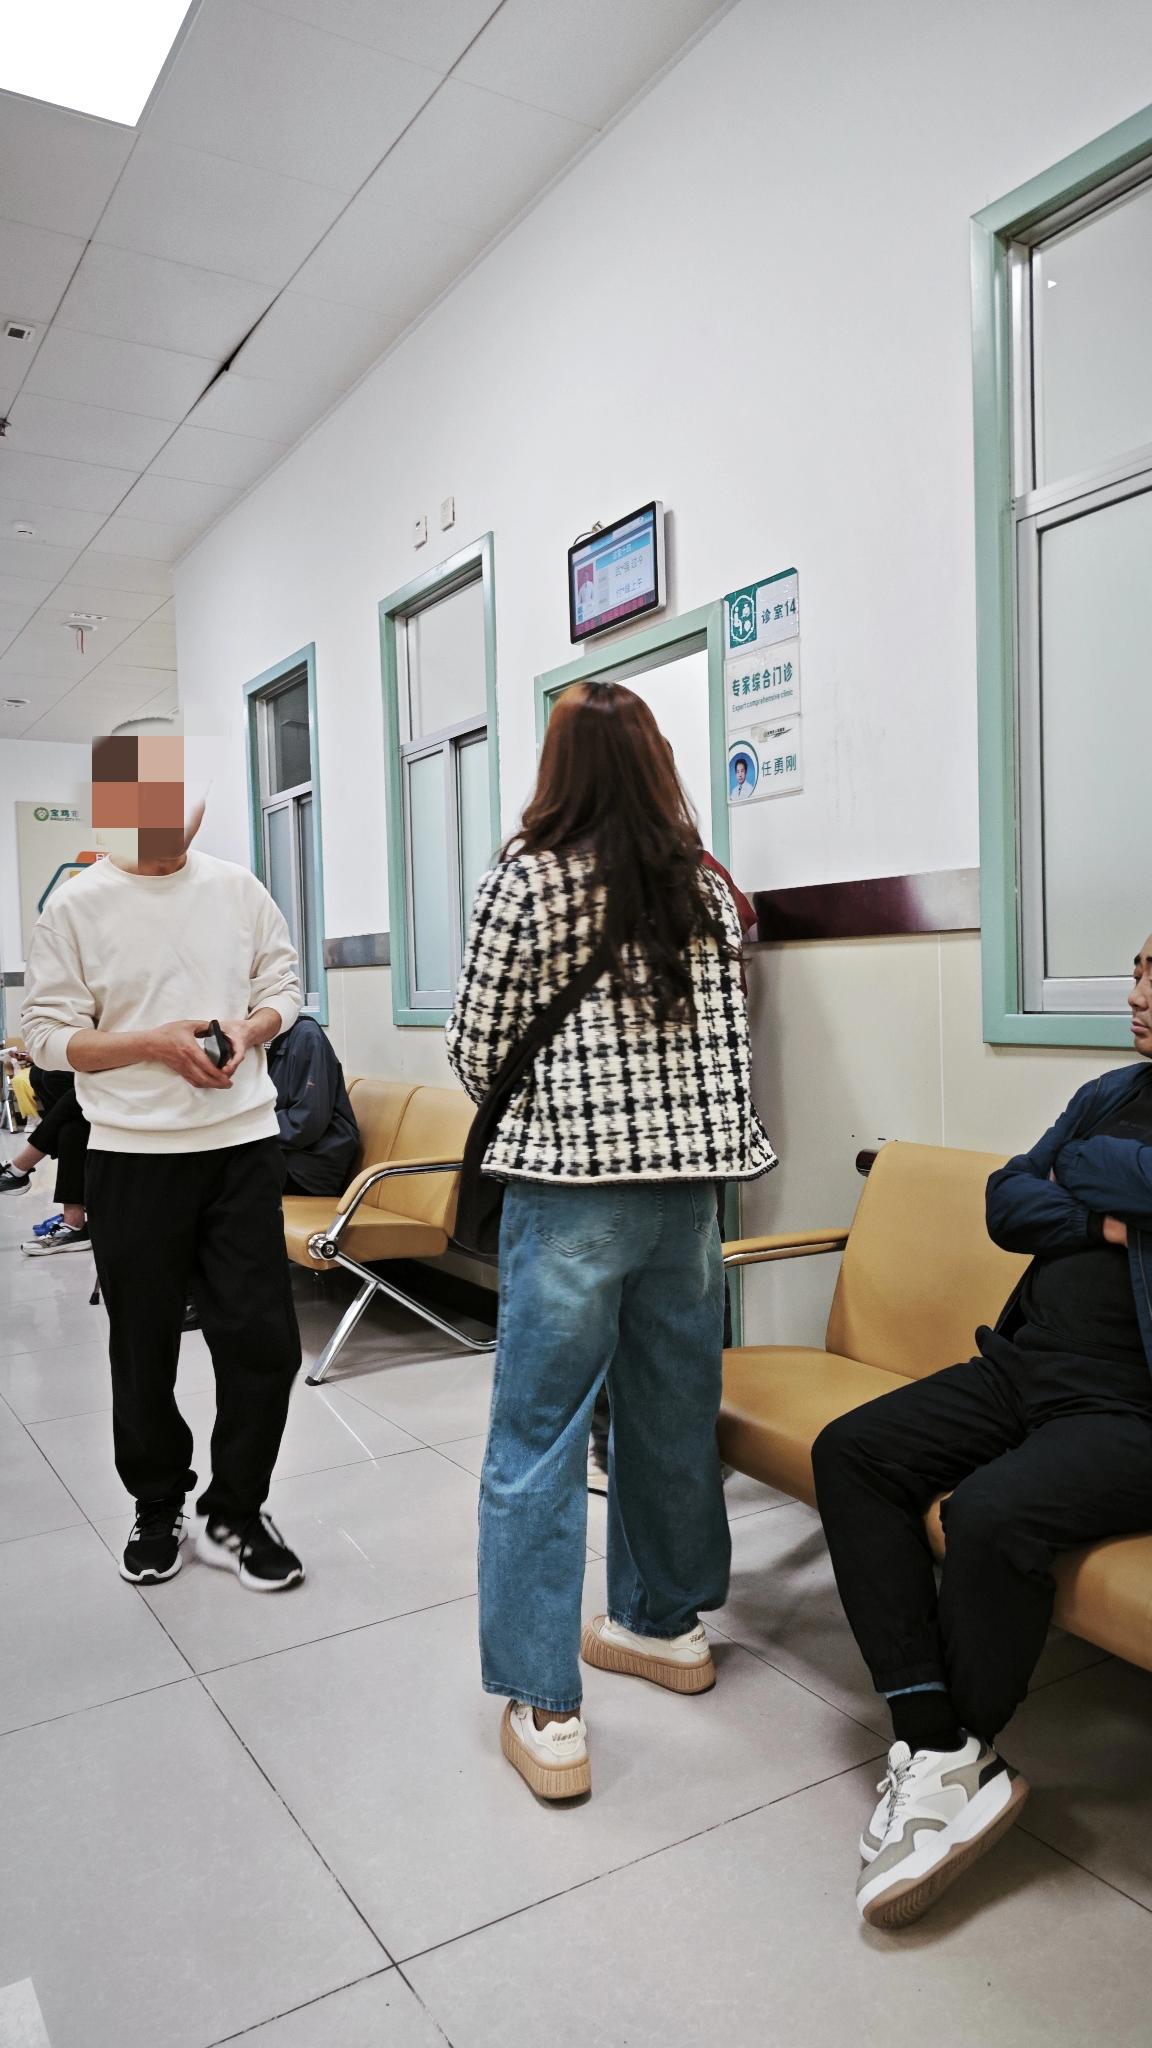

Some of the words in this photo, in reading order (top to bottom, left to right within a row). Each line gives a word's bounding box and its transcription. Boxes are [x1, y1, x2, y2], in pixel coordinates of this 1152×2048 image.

[761, 598, 797, 624] 诊室14
[732, 661, 793, 697] 专家综合门诊
[732, 702, 748, 713] Expert
[761, 753, 797, 778] 任勇刚
